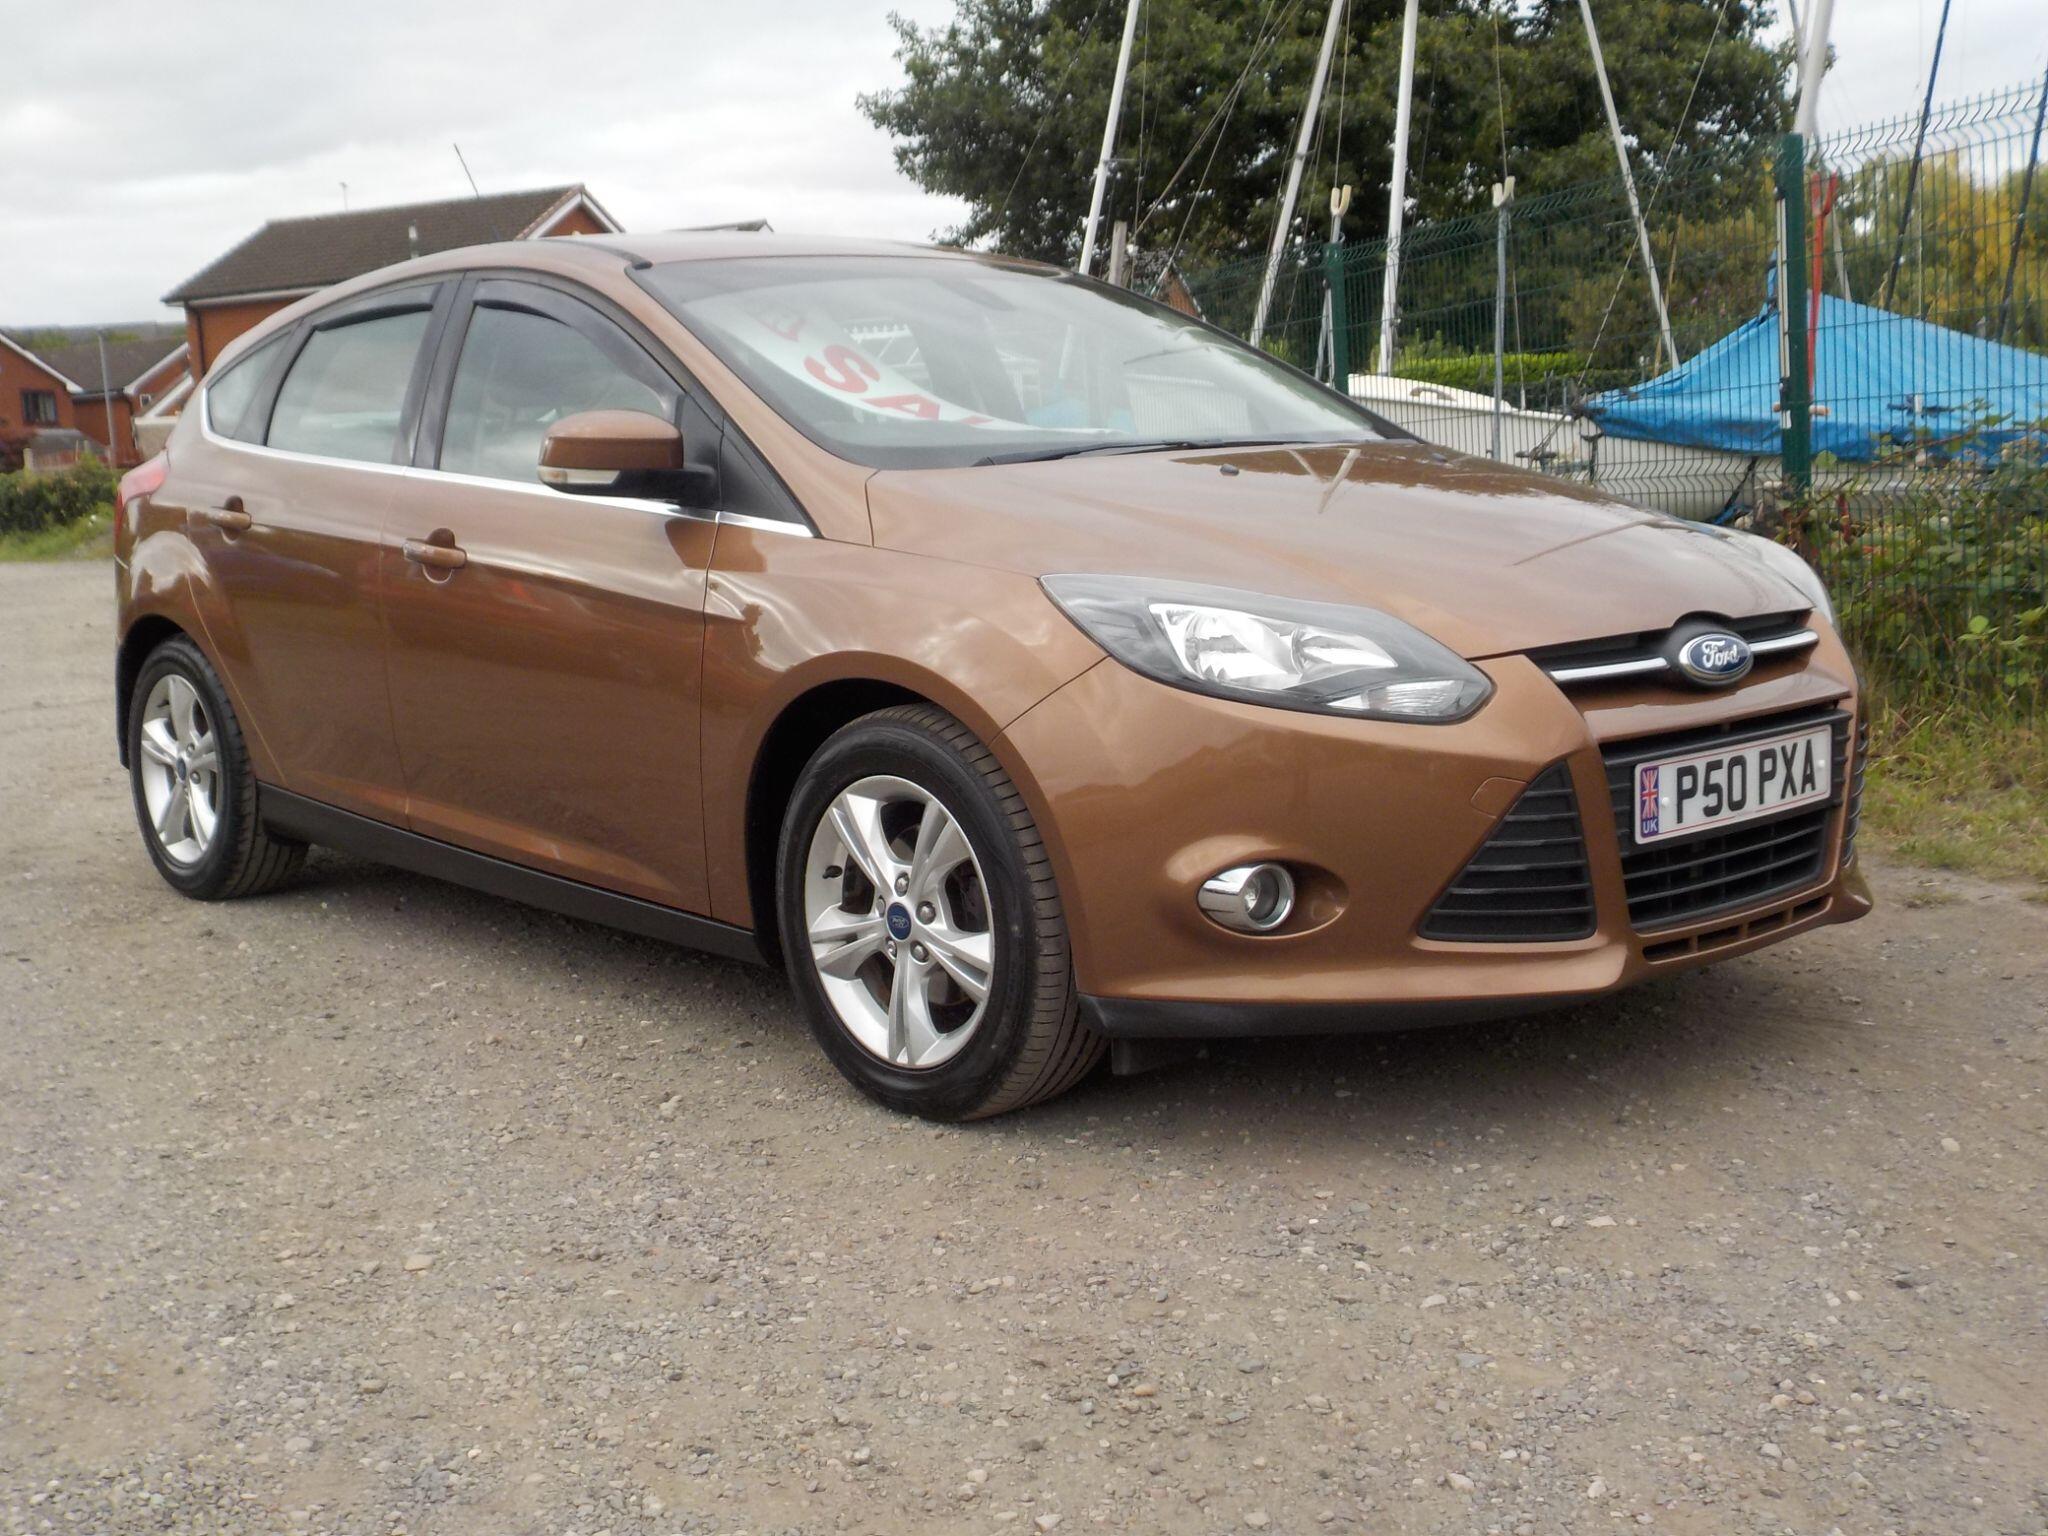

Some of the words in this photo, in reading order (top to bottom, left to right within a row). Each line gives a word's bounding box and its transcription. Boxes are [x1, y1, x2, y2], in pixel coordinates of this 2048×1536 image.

[1702, 640, 1740, 668] Ford
[1677, 755, 1747, 824] P50
[1759, 739, 1816, 805] PXA
[1643, 819, 1658, 834] UK
